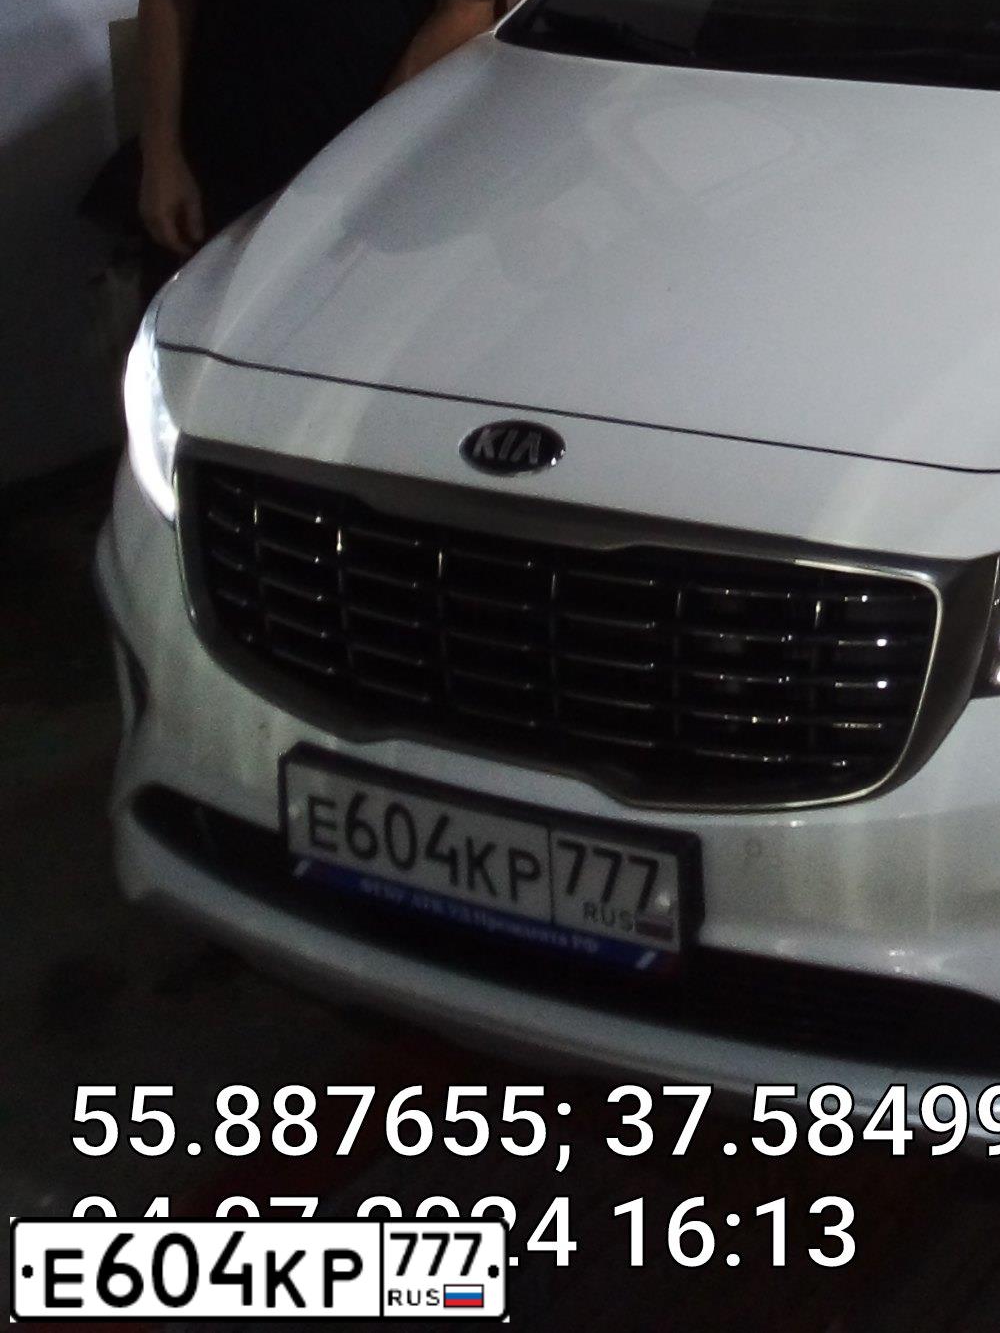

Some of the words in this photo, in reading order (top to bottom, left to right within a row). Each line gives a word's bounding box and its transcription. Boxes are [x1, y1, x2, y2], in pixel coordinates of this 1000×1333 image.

[471, 427, 541, 465] KIA
[557, 839, 661, 913] 777
[582, 900, 635, 934] RUS
